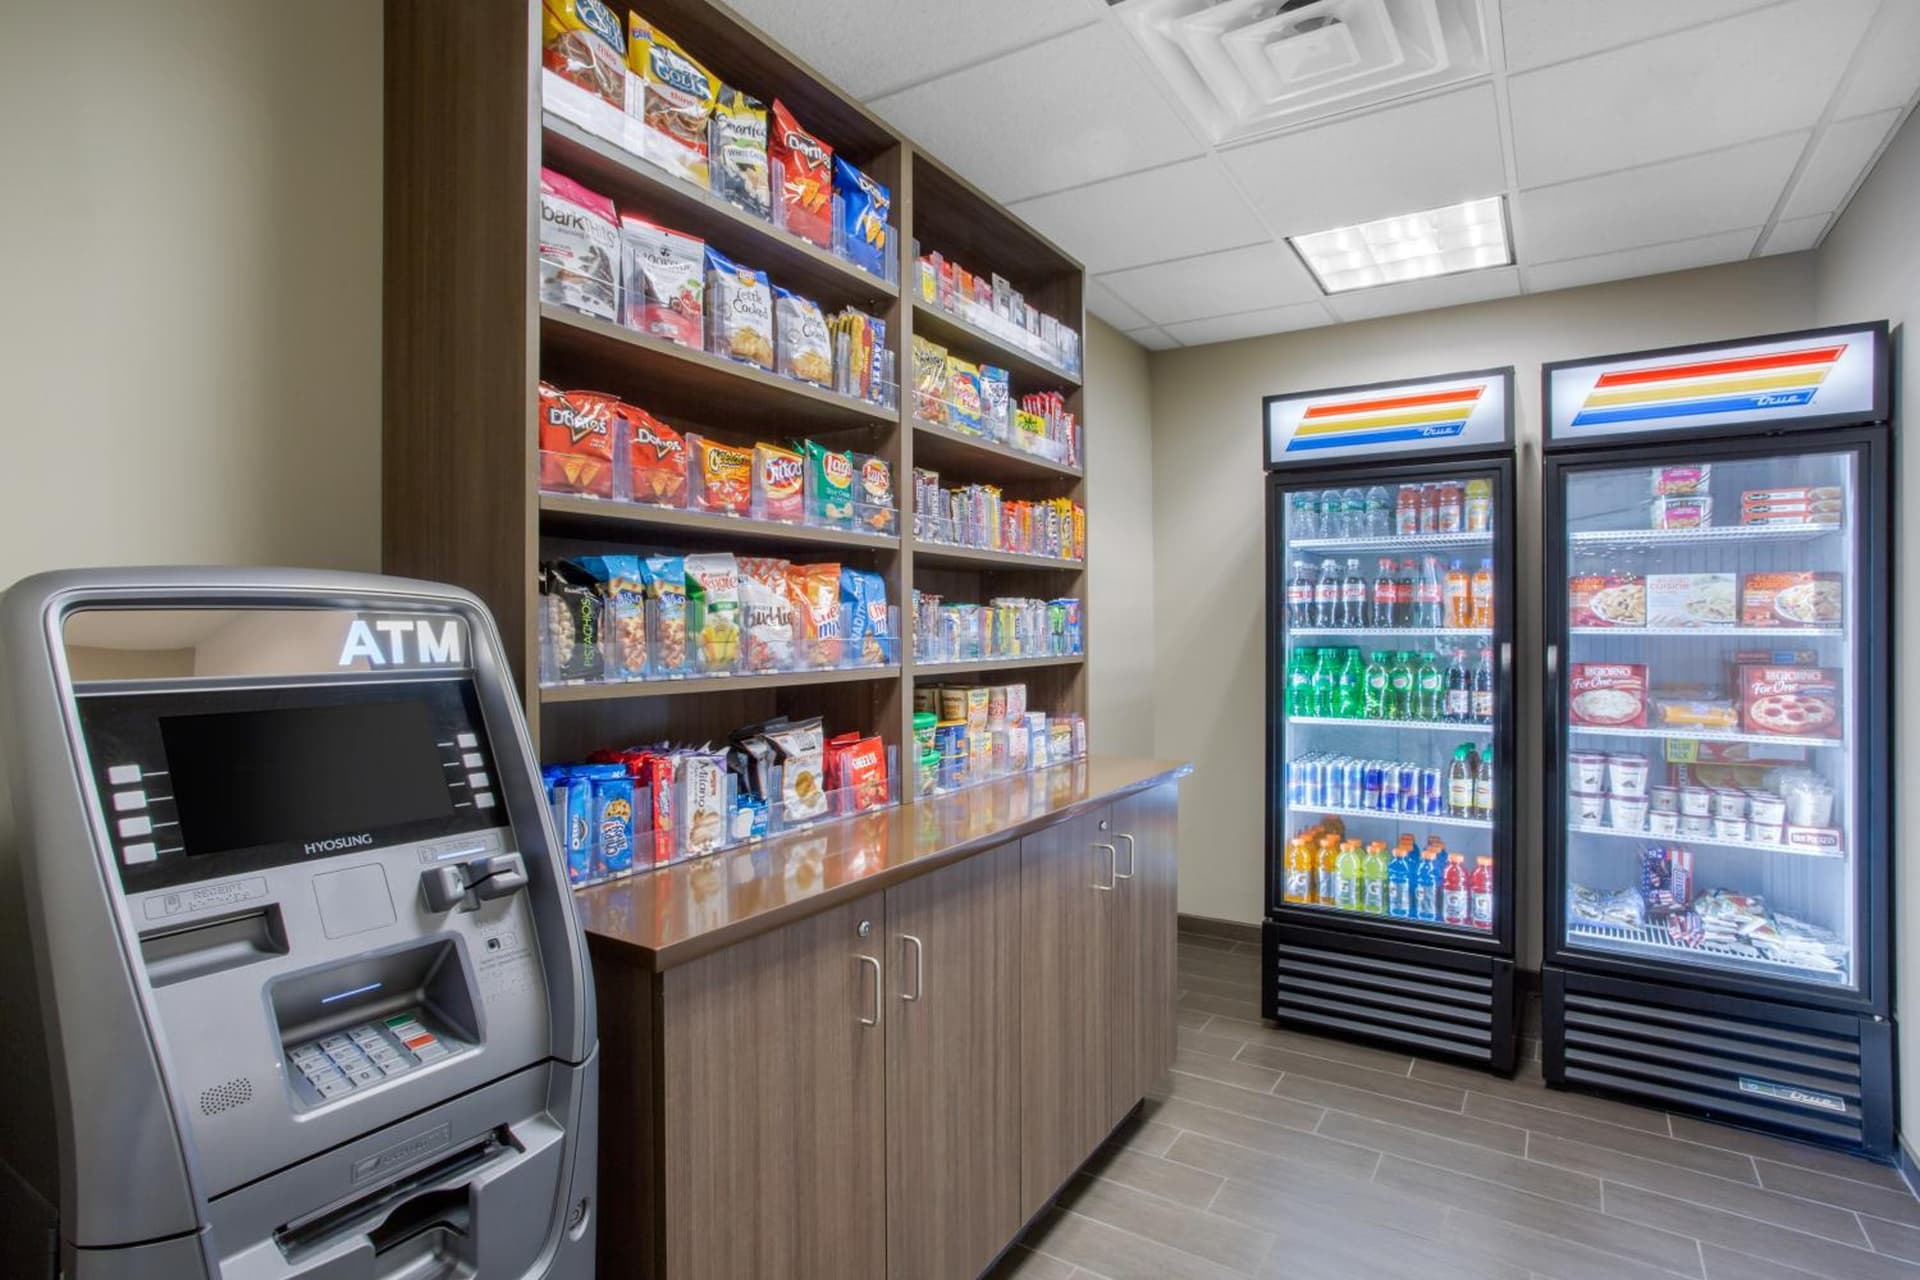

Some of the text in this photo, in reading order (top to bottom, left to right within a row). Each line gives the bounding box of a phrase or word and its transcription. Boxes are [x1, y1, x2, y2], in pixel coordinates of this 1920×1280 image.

[1755, 393, 1802, 406] True
[549, 406, 607, 434] Doritos
[1420, 425, 1456, 437] True
[638, 427, 683, 452] Doritos
[339, 620, 461, 666] ATM
[581, 598, 594, 668] PISTACHIOS
[1572, 675, 1613, 690] For One
[1752, 680, 1799, 695] For One
[698, 760, 709, 808] Milano
[304, 832, 373, 855] HYOSUNG
[1789, 1090, 1833, 1107] True
